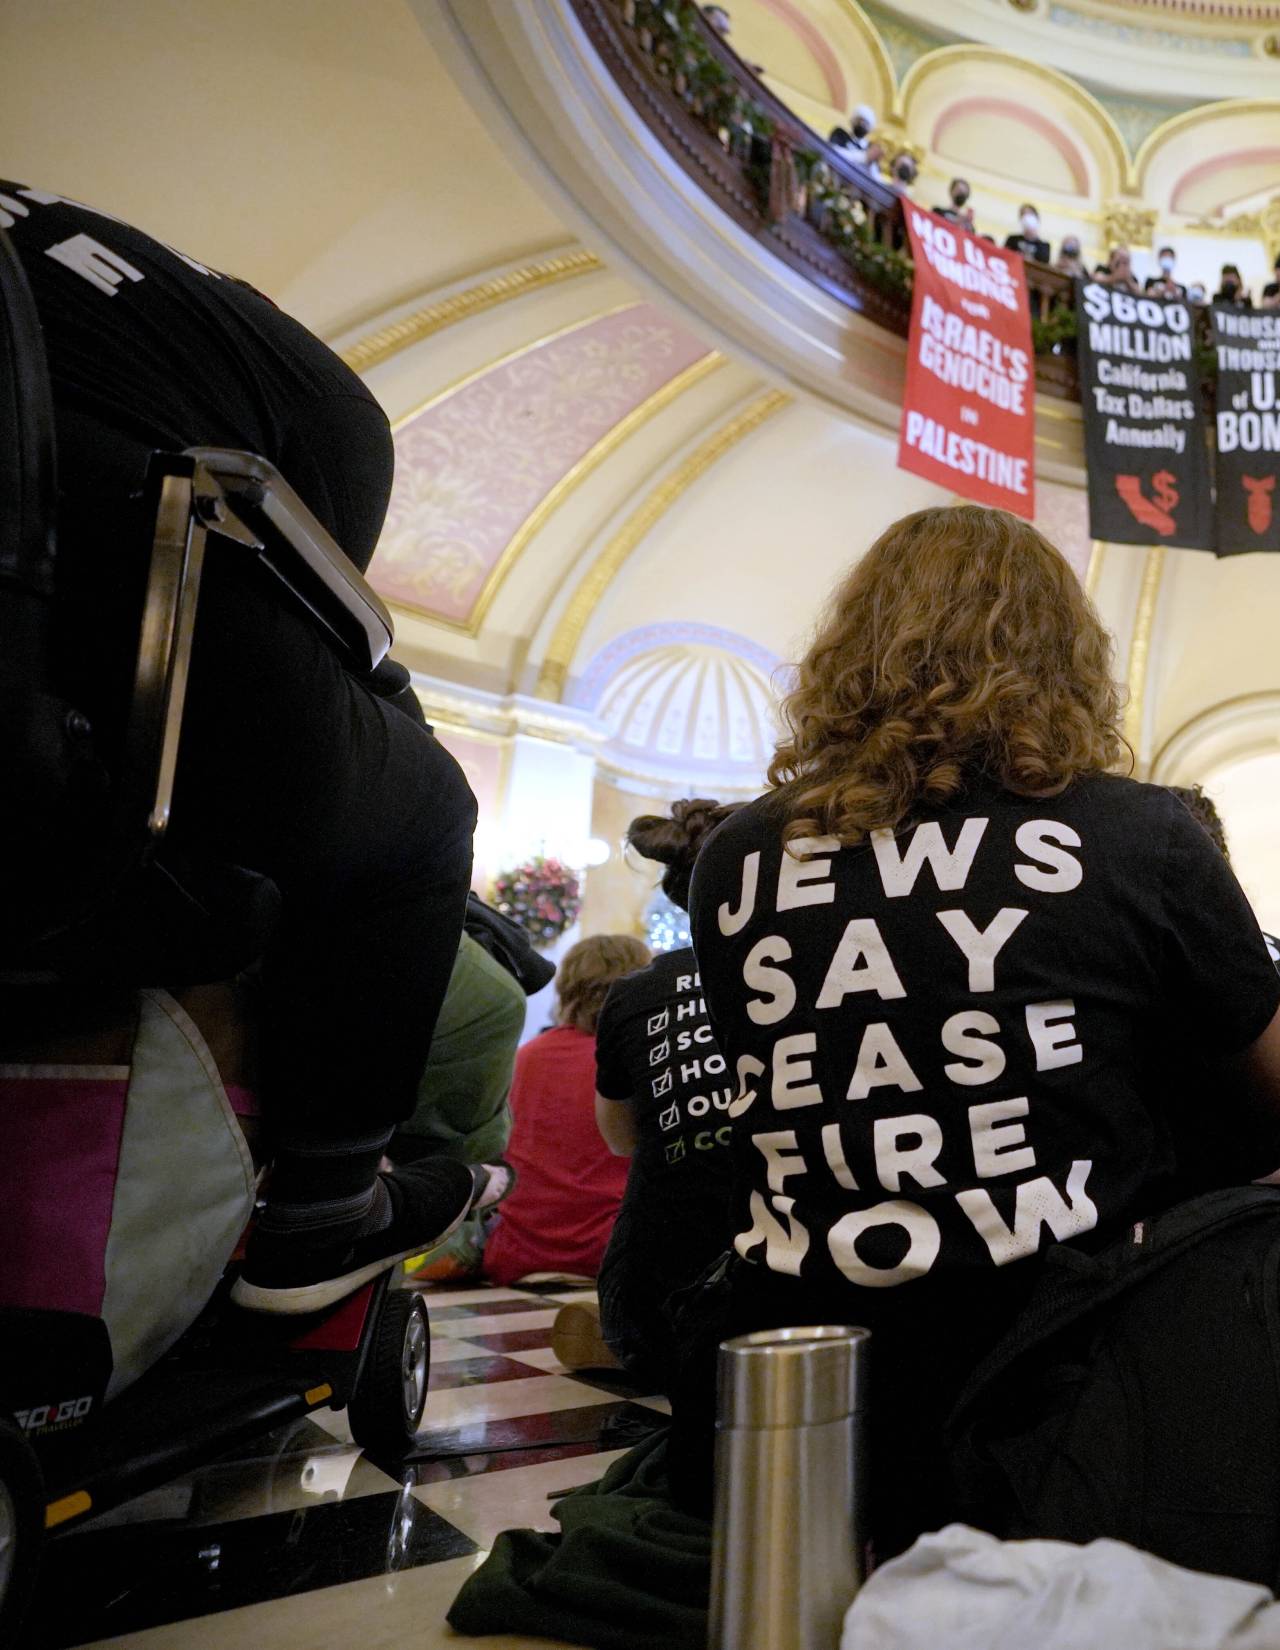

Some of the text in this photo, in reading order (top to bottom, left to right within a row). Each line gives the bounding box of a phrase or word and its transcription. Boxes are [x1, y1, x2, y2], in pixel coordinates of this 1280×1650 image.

[920, 295, 1029, 383] ISRAEL'S
[1083, 283, 1190, 333] $600
[1089, 322, 1192, 363] MILLION
[918, 332, 1027, 416] GENOCIDE
[1092, 387, 1195, 420] Tax Dollars
[1097, 358, 1188, 392] California
[1232, 390, 1248, 411] of
[905, 410, 1029, 496] PALESTINE
[1105, 419, 1187, 454] Annually
[718, 817, 1083, 937] JEWS
[742, 907, 1030, 1026] SAY
[728, 1000, 1084, 1118] CEASE
[752, 1097, 1037, 1194] FIRE
[734, 1160, 1098, 1288] NOW
